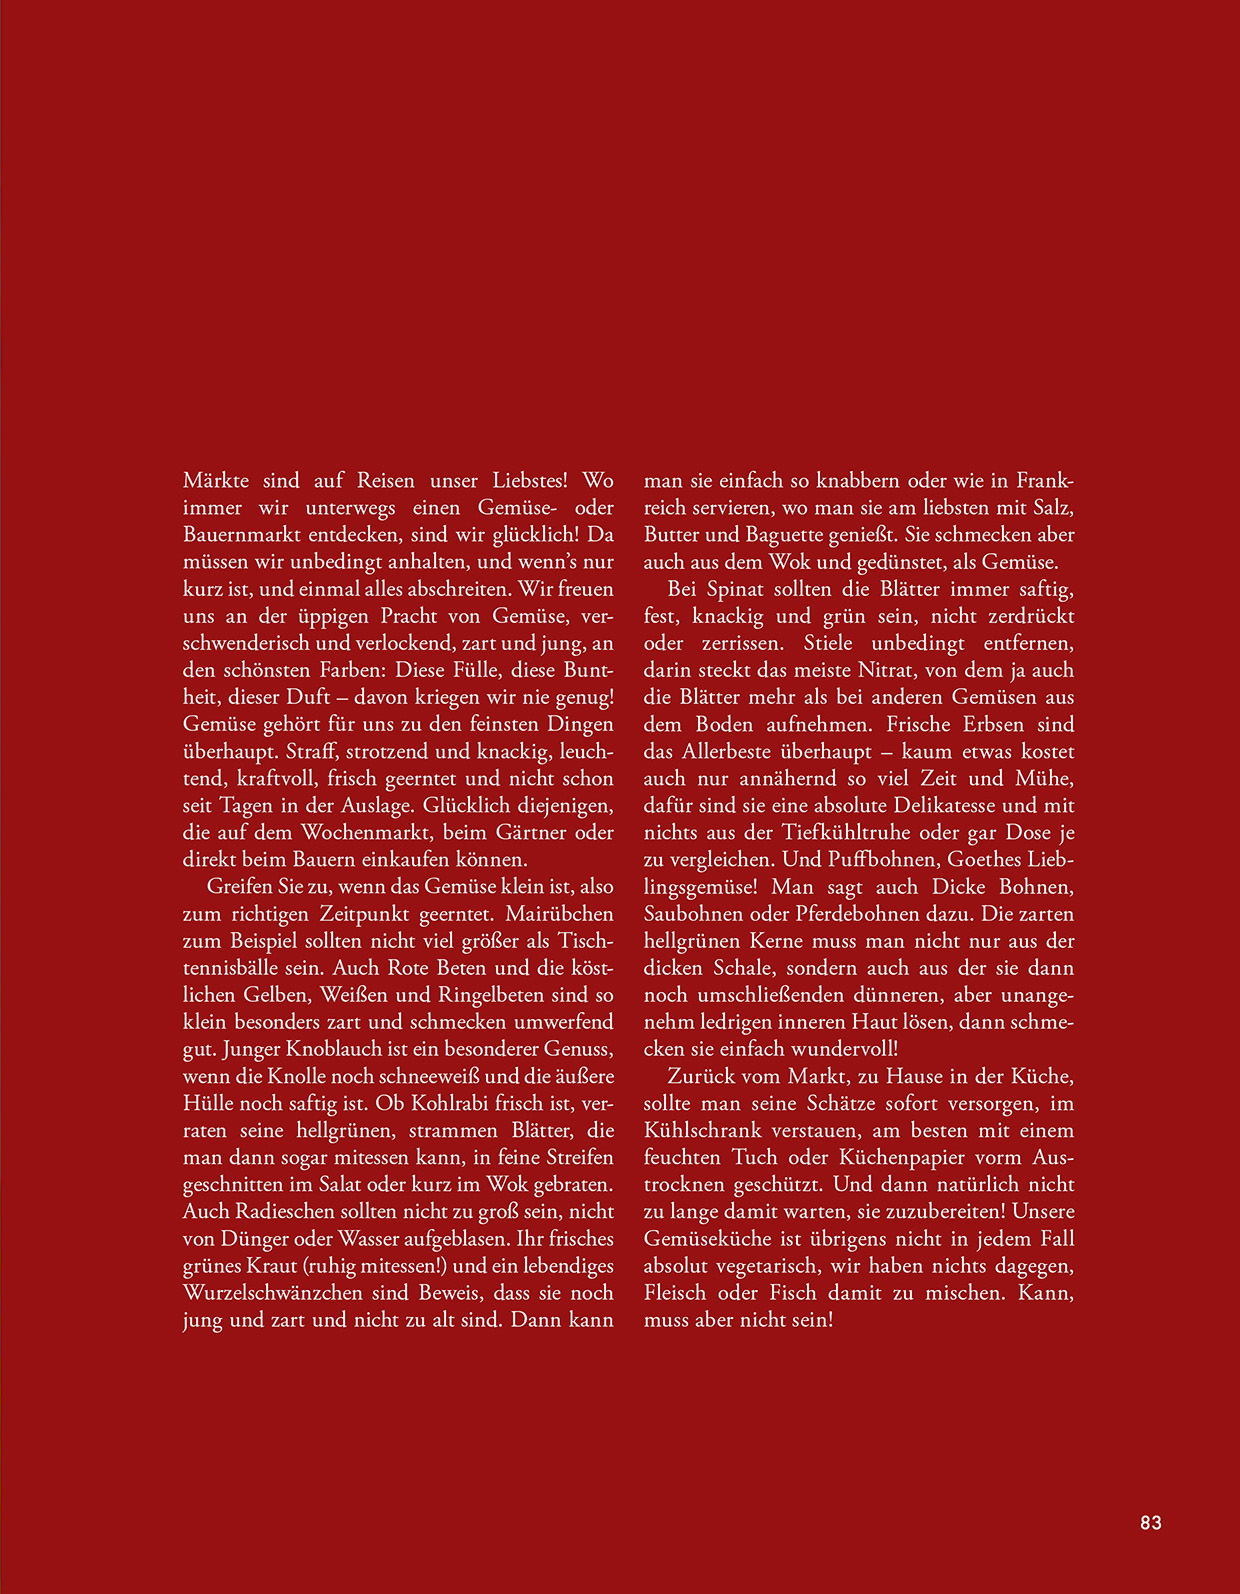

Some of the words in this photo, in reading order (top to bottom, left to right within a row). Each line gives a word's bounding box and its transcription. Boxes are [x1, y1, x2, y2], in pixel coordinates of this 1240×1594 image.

[182, 470, 250, 489] Märkte
[262, 470, 301, 489] sind
[314, 470, 346, 489] auf
[357, 470, 415, 489] Reisen
[430, 476, 479, 489] unser
[492, 470, 568, 489] Liebstes!
[581, 471, 614, 489] Wo
[643, 477, 683, 489] man
[690, 472, 713, 489] sie
[719, 470, 784, 489] einfach
[790, 476, 810, 489] so
[816, 470, 900, 489] knabbern
[907, 470, 948, 489] oder
[953, 472, 985, 489] wie
[990, 472, 1009, 489] in
[1016, 470, 1075, 489] Frank-
[183, 553, 249, 570] müssen
[254, 553, 285, 570] wir
[290, 551, 383, 576] unbedingt
[388, 551, 471, 572] anhalten,
[477, 551, 513, 570] und
[517, 551, 577, 570] wenn’s
[583, 557, 615, 570] nur
[643, 551, 686, 570] auch
[690, 558, 719, 570] aus
[724, 551, 764, 571] dem
[767, 551, 812, 570] Wok
[816, 551, 853, 571] und
[856, 551, 948, 576] gedünstet,
[952, 551, 977, 570] als
[981, 552, 1059, 570] Gemüse.
[182, 632, 311, 652] schwenderisch
[315, 632, 352, 652] und
[355, 632, 457, 654] verlockend,
[461, 638, 497, 651] zart
[501, 632, 537, 652] und
[540, 634, 587, 657] jung,
[591, 639, 615, 651] an
[643, 632, 684, 652] oder
[701, 634, 785, 651] zerrissen.
[803, 632, 853, 651] Stiele
[871, 632, 966, 657] unbedingt
[983, 632, 1074, 654] entfernen,
[643, 714, 682, 733] dem
[695, 714, 754, 733] Boden
[766, 713, 873, 733] aufnehmen.
[886, 714, 951, 733] Frische
[963, 714, 1025, 733] Erbsen
[1037, 714, 1075, 733] sind
[183, 741, 279, 766] überhaupt.
[285, 740, 340, 762] Straff,
[345, 741, 429, 760] strotzend
[435, 741, 471, 760] und
[476, 741, 553, 766] knackig,
[559, 741, 614, 760] leuch-
[182, 822, 211, 841] die
[217, 821, 250, 841] auf
[254, 822, 293, 841] dem
[300, 822, 434, 843] Wochenmarkt,
[442, 822, 488, 841] beim
[495, 822, 568, 841] Gärtner
[574, 822, 615, 841] oder
[643, 876, 758, 901] lingsgemüse!
[771, 877, 815, 895] Man
[827, 882, 864, 901] sagt
[875, 876, 919, 895] auch
[932, 876, 986, 895] Dicke
[999, 876, 1074, 898] Bohnen,
[182, 910, 222, 922] zum
[231, 903, 310, 928] richtigen
[319, 903, 410, 928] Zeitpunkt
[419, 909, 495, 928] geerntet.
[505, 903, 615, 922] Mairübchen
[182, 984, 236, 1003] lichen
[243, 984, 312, 1006] Gelben,
[319, 984, 389, 1003] Weißen
[395, 984, 432, 1003] und
[438, 984, 545, 1009] Ringelbeten
[551, 984, 589, 1004] sind
[595, 991, 614, 1003] so
[643, 984, 689, 1003] noch
[697, 984, 845, 1004] umschließenden
[853, 984, 945, 1006] dünneren,
[953, 984, 993, 1003] aber
[1001, 991, 1075, 1009] unange-
[182, 1072, 231, 1085] wenn
[235, 1066, 263, 1085] die
[267, 1066, 327, 1085] Knolle
[330, 1066, 375, 1085] noch
[378, 1065, 480, 1085] schneeweiß
[484, 1066, 521, 1085] und
[523, 1066, 552, 1085] die
[555, 1065, 615, 1085] äußere
[667, 1066, 737, 1085] Zurück
[741, 1072, 781, 1085] vom
[787, 1066, 851, 1087] Markt,
[857, 1072, 879, 1085] zu
[886, 1066, 944, 1085] Hause
[949, 1067, 969, 1085] in
[974, 1066, 1005, 1085] der
[1011, 1066, 1074, 1087] Küche,
[183, 1153, 223, 1165] man
[229, 1147, 276, 1166] dann
[280, 1153, 329, 1171] sogar
[333, 1149, 410, 1166] mitessen
[415, 1147, 466, 1168] kann,
[473, 1149, 492, 1166] in
[497, 1146, 541, 1166] feine
[546, 1146, 615, 1165] Streifen
[643, 1146, 722, 1166] feuchten
[730, 1147, 779, 1166] Tuch
[788, 1147, 829, 1166] oder
[839, 1147, 966, 1171] Küchenpapier
[974, 1153, 1022, 1166] vorm
[1031, 1148, 1075, 1166] Aus-
[182, 1235, 216, 1247] von
[220, 1229, 290, 1253] Dünger
[293, 1228, 334, 1247] oder
[336, 1229, 400, 1247] Wasser
[404, 1228, 511, 1253] aufgeblasen.
[516, 1228, 545, 1247] Ihr
[548, 1228, 614, 1247] frisches
[643, 1228, 772, 1247] Gemüseküche
[780, 1230, 802, 1247] ist
[810, 1228, 887, 1253] übrigens
[895, 1228, 943, 1247] nicht
[950, 1230, 969, 1247] in
[976, 1228, 1032, 1253] jedem
[1040, 1228, 1075, 1247] Fall
[181, 1311, 224, 1334] jung
[229, 1309, 265, 1328] und
[270, 1315, 306, 1328] zart
[312, 1309, 348, 1328] und
[353, 1309, 400, 1328] nicht
[405, 1316, 427, 1328] zu
[432, 1309, 456, 1328] alt
[460, 1309, 503, 1328] sind.
[510, 1310, 562, 1328] Dann
[568, 1309, 615, 1328] kann
[643, 1316, 689, 1328] muss
[695, 1309, 734, 1328] aber
[739, 1309, 787, 1328] nicht
[791, 1310, 833, 1328] sein!
[1140, 1514, 1162, 1531] 83
